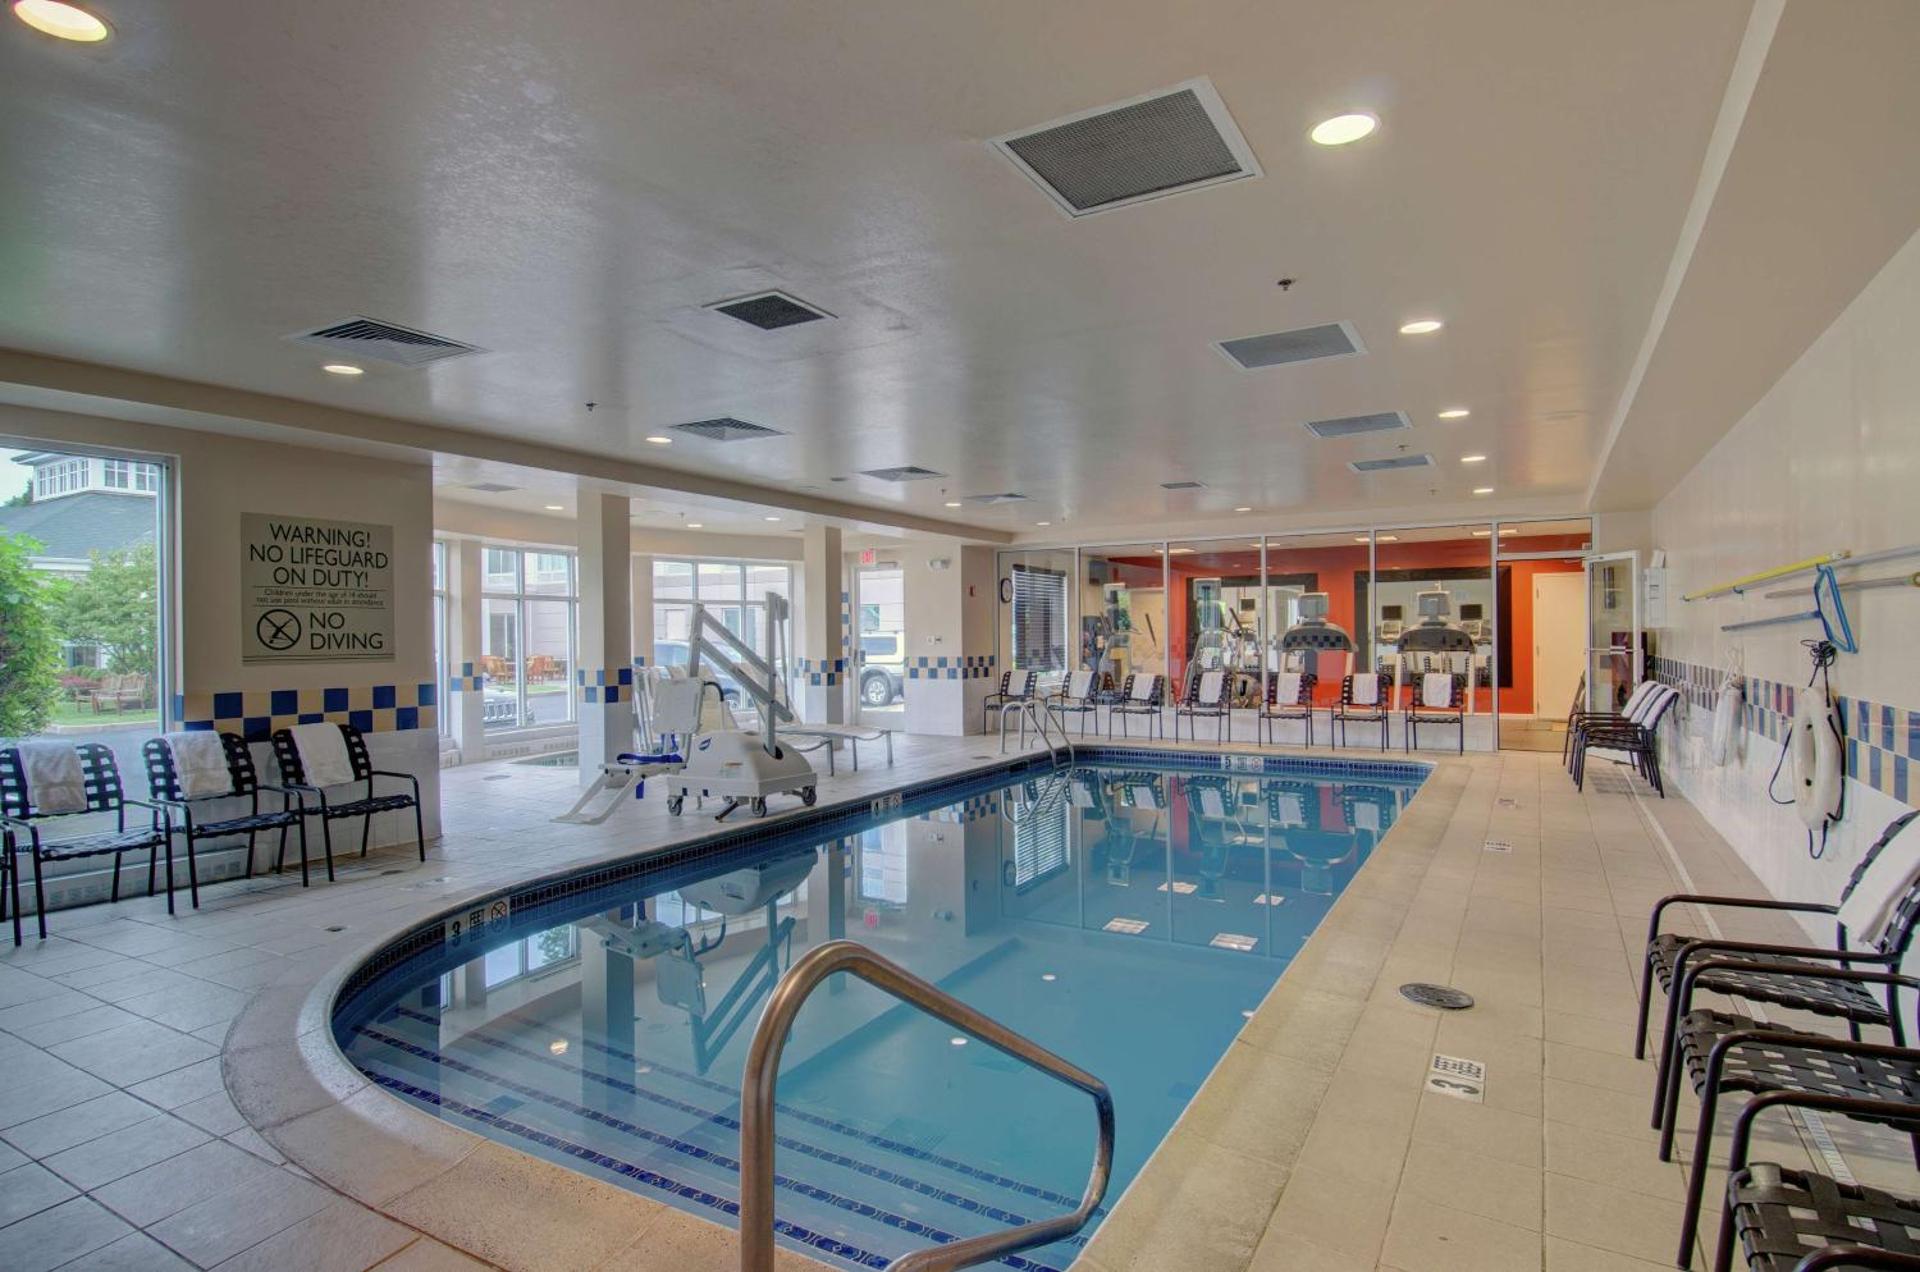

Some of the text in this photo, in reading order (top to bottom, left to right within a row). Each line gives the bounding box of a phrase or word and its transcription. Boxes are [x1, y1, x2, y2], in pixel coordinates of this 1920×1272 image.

[269, 523, 370, 548] WARNING!
[250, 544, 389, 569] NO LIFEGUARD
[273, 567, 369, 588] ON DUTY!
[294, 589, 313, 597] under
[310, 612, 345, 629] NO
[310, 633, 384, 650] DIVING
